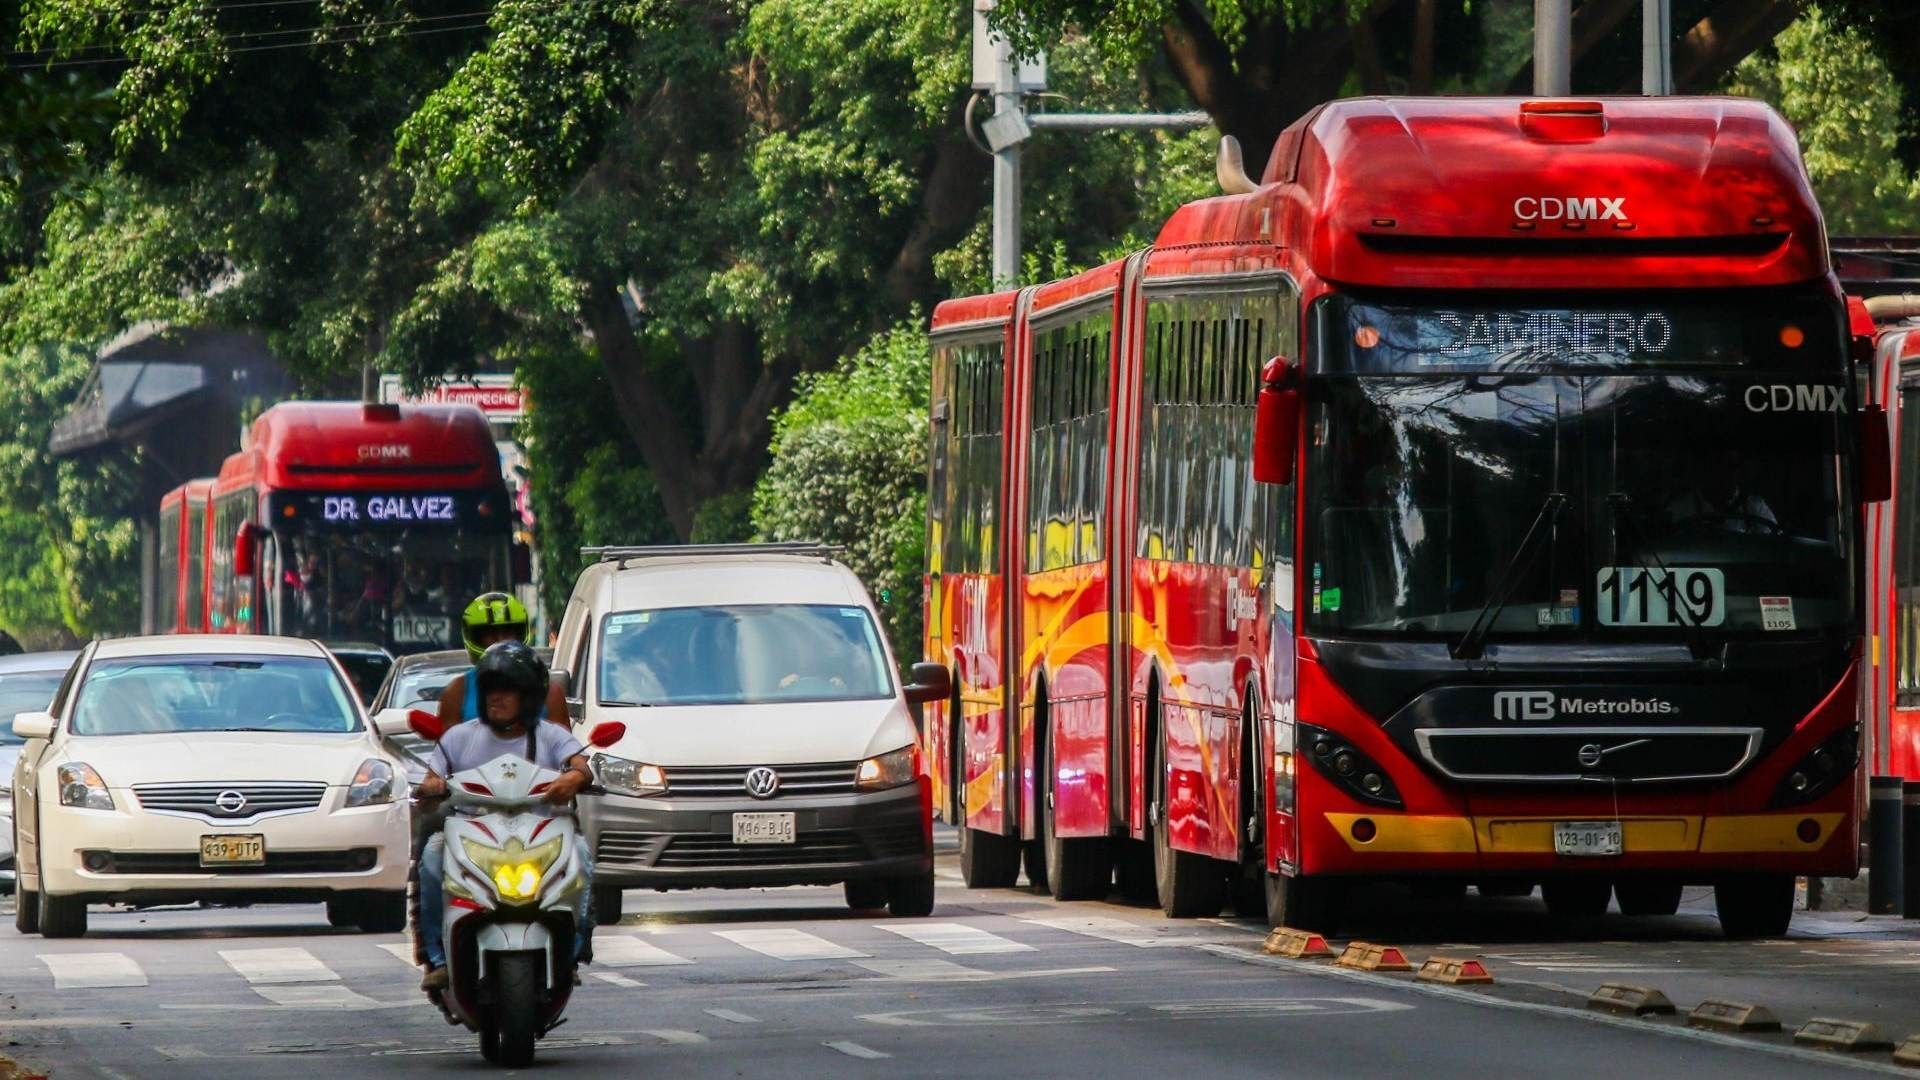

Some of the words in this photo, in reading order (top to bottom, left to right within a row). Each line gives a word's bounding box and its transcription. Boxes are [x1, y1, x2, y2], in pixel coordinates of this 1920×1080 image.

[1514, 196, 1628, 220] CDMX
[1744, 384, 1848, 413] CDMX
[358, 445, 410, 458] CDMX
[324, 496, 359, 519] DR.
[368, 496, 453, 519] GALVEZ
[1601, 571, 1713, 624] 1119
[1558, 832, 1620, 846] 123-01-10
